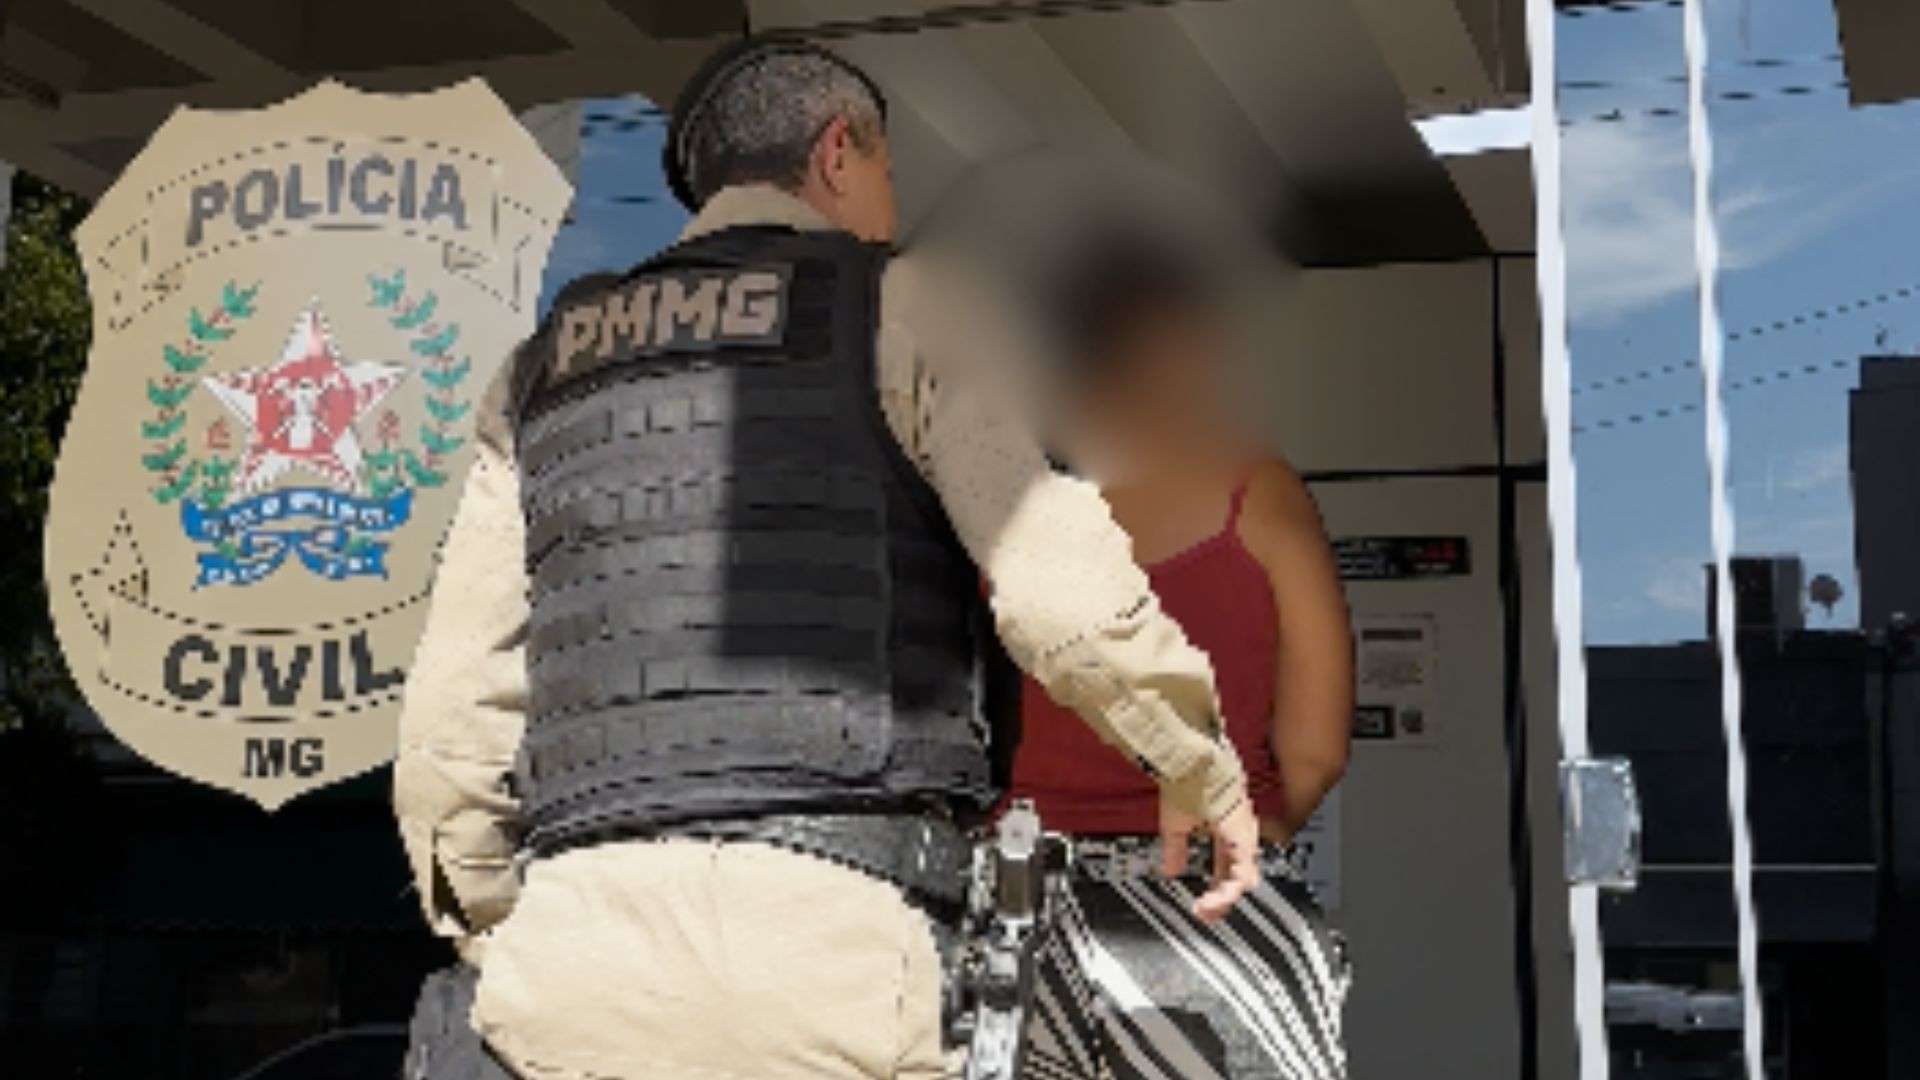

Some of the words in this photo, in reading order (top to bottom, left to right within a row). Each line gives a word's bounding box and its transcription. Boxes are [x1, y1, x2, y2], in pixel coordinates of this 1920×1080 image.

[185, 142, 469, 247] POLÍCIA
[556, 272, 782, 376] PMMG
[163, 630, 405, 707] CIVIL
[242, 738, 325, 778] MG
